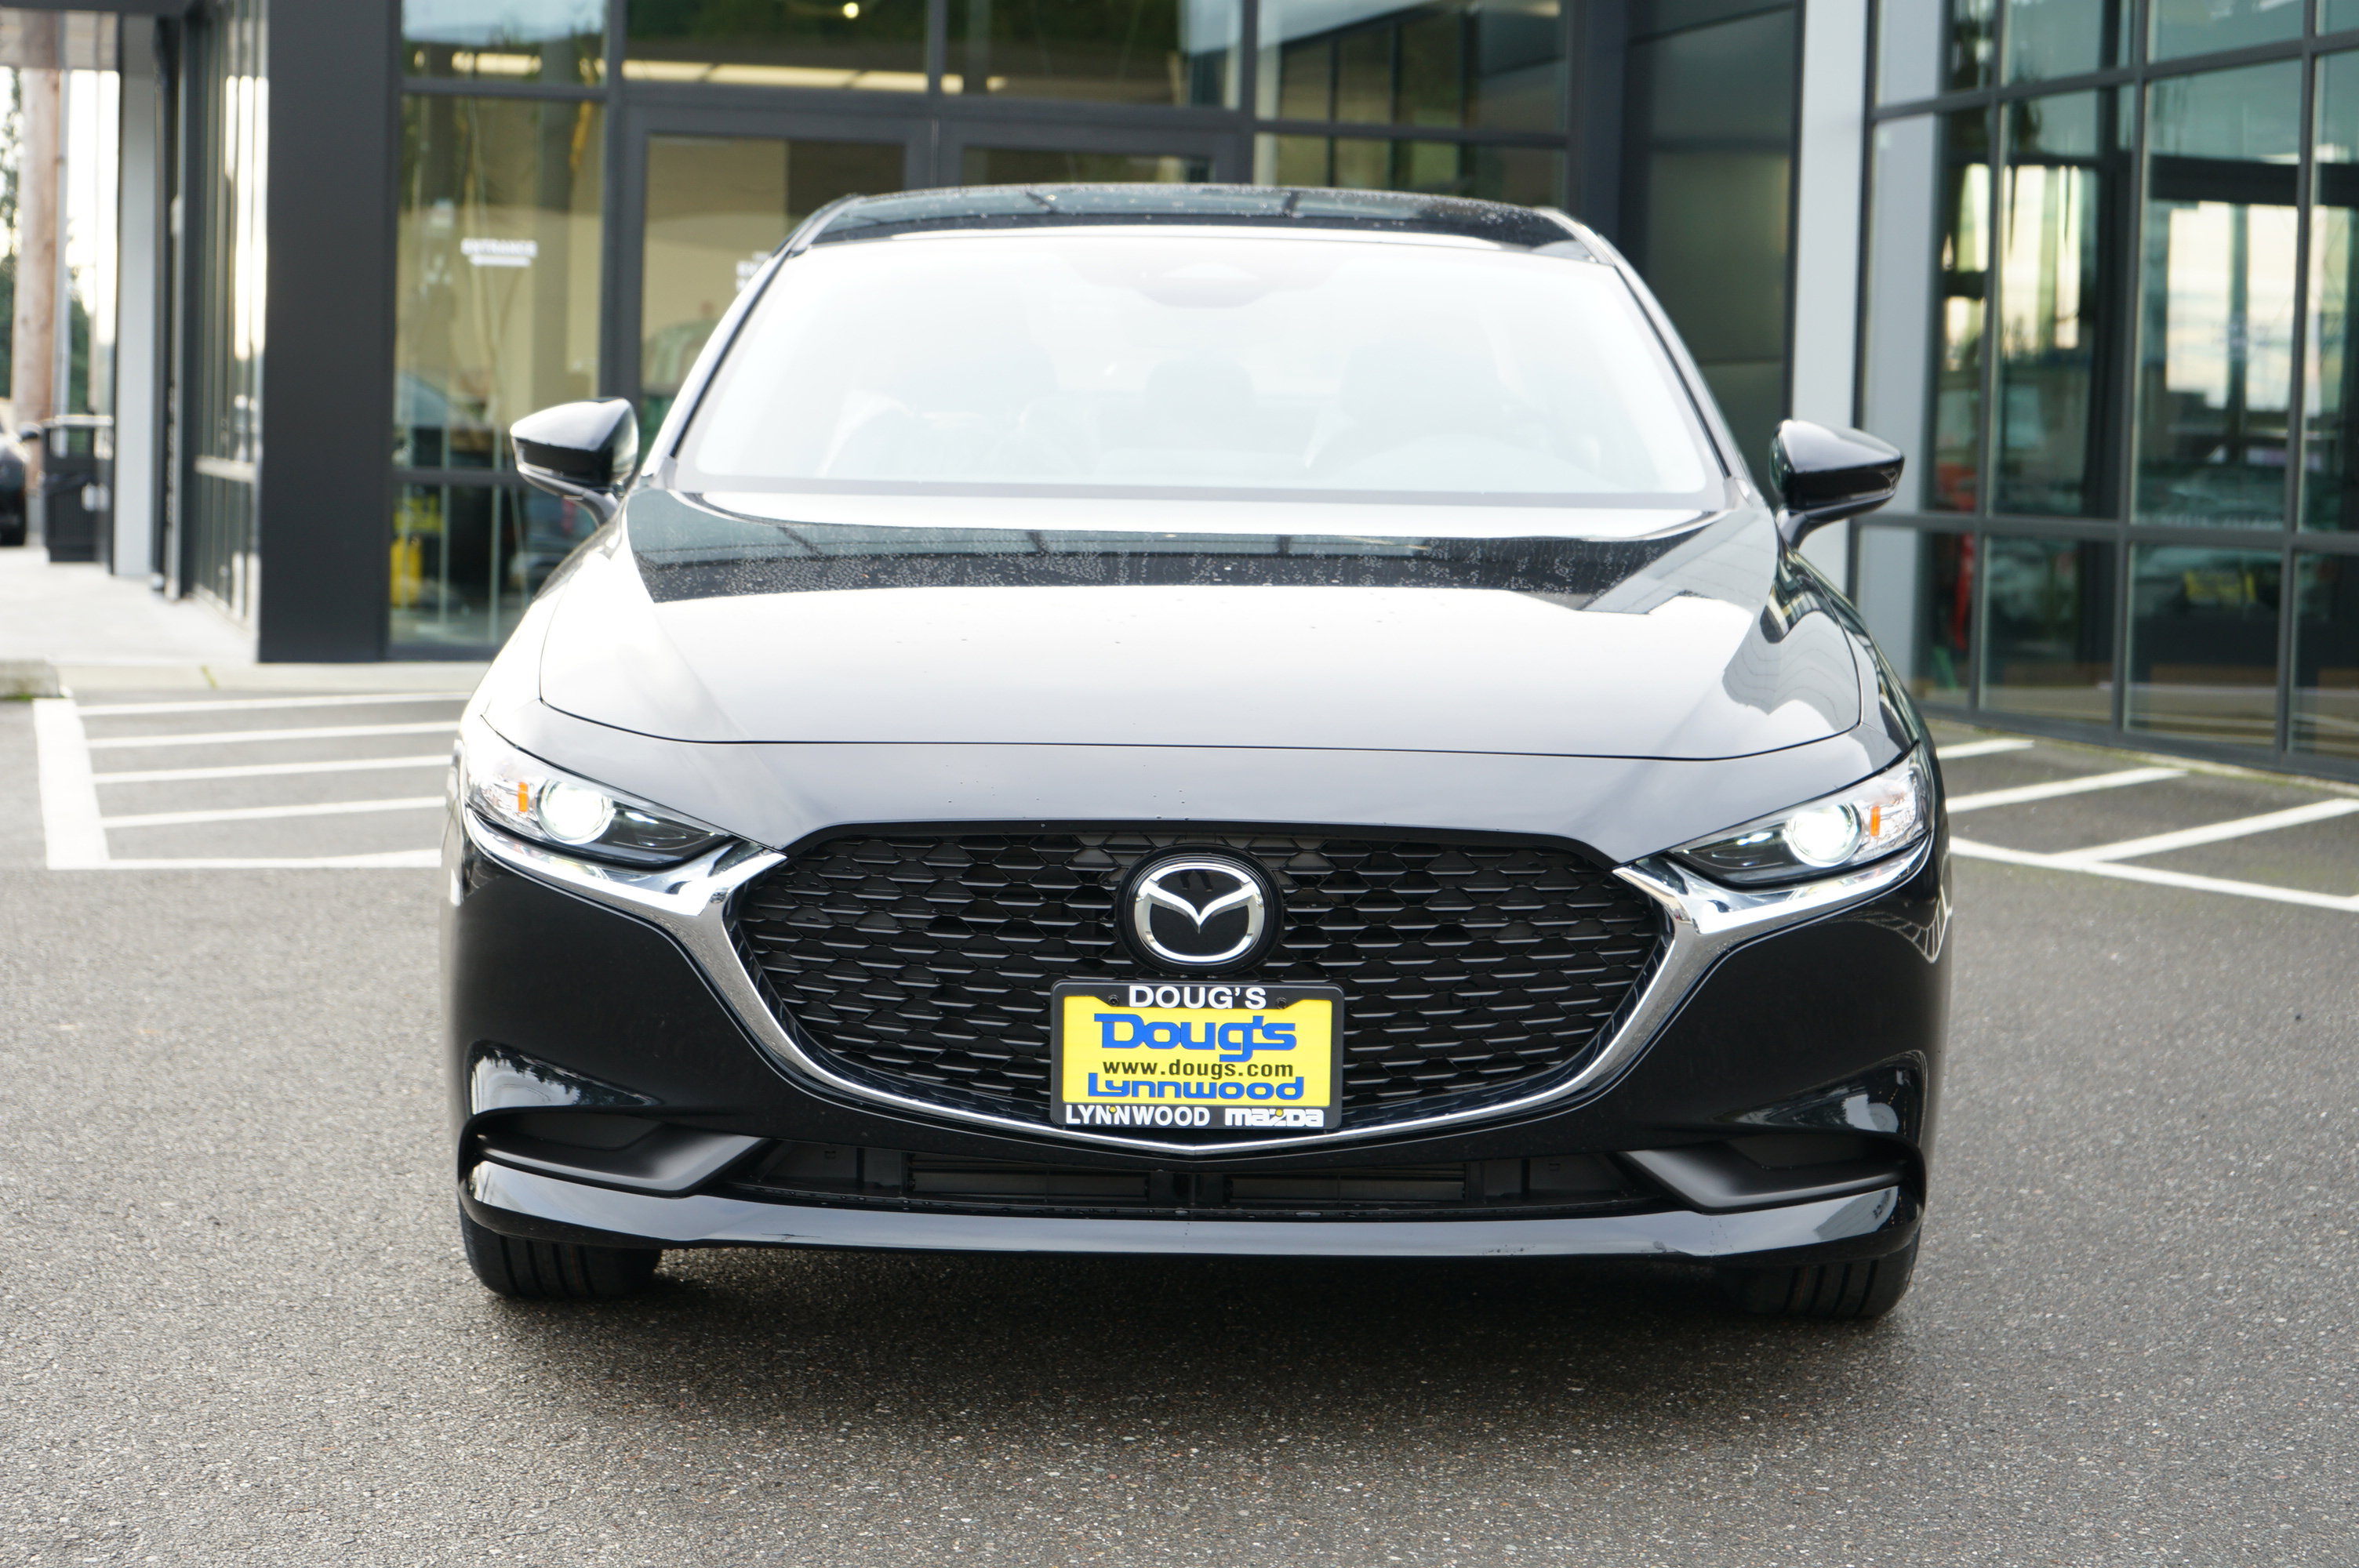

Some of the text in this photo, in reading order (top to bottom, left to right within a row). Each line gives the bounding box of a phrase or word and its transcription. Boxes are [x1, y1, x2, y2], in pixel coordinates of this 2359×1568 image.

[1129, 985, 1267, 1009] DOUG'S
[1103, 1059, 1293, 1080] www.dougs.com
[1088, 1073, 1304, 1100] Lynnwood
[1066, 1105, 1210, 1126] LYNNWOOD
